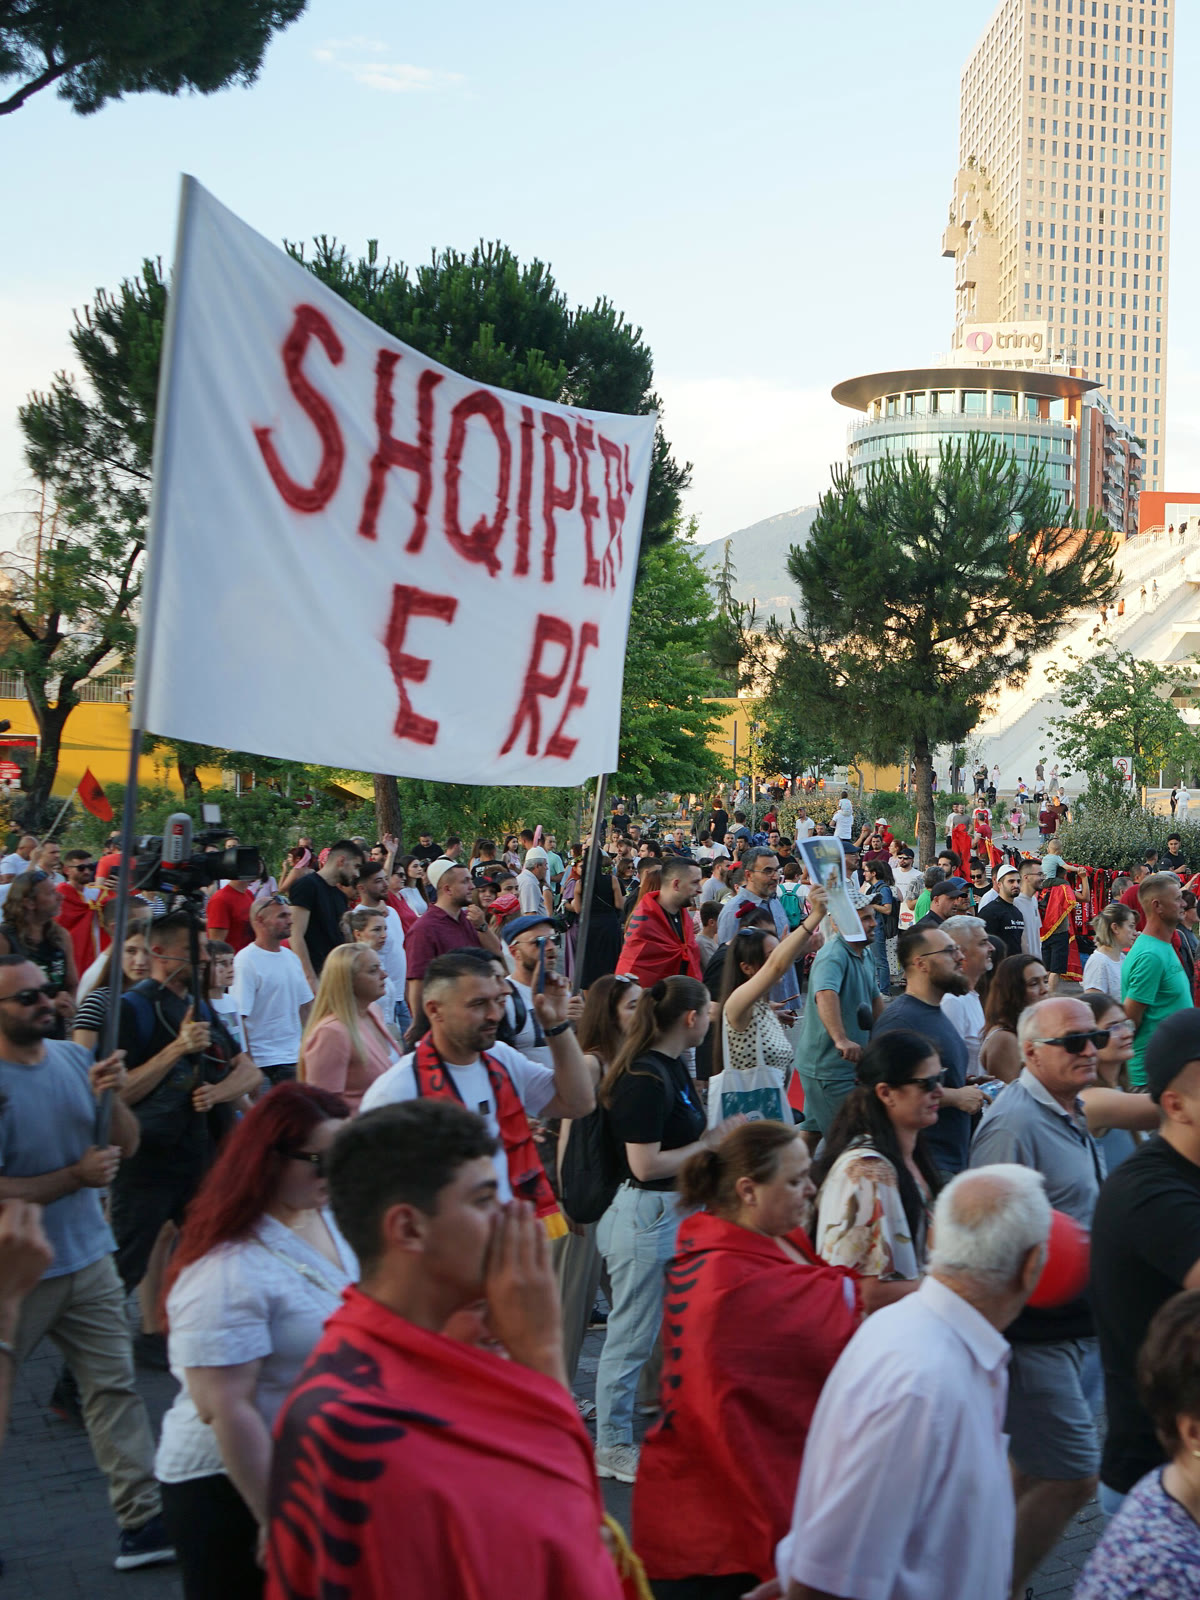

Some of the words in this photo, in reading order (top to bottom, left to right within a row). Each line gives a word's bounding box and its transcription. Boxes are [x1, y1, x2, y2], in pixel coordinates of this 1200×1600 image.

[996, 329, 1043, 353] tring
[381, 583, 460, 746] E
[499, 613, 599, 761] RE
